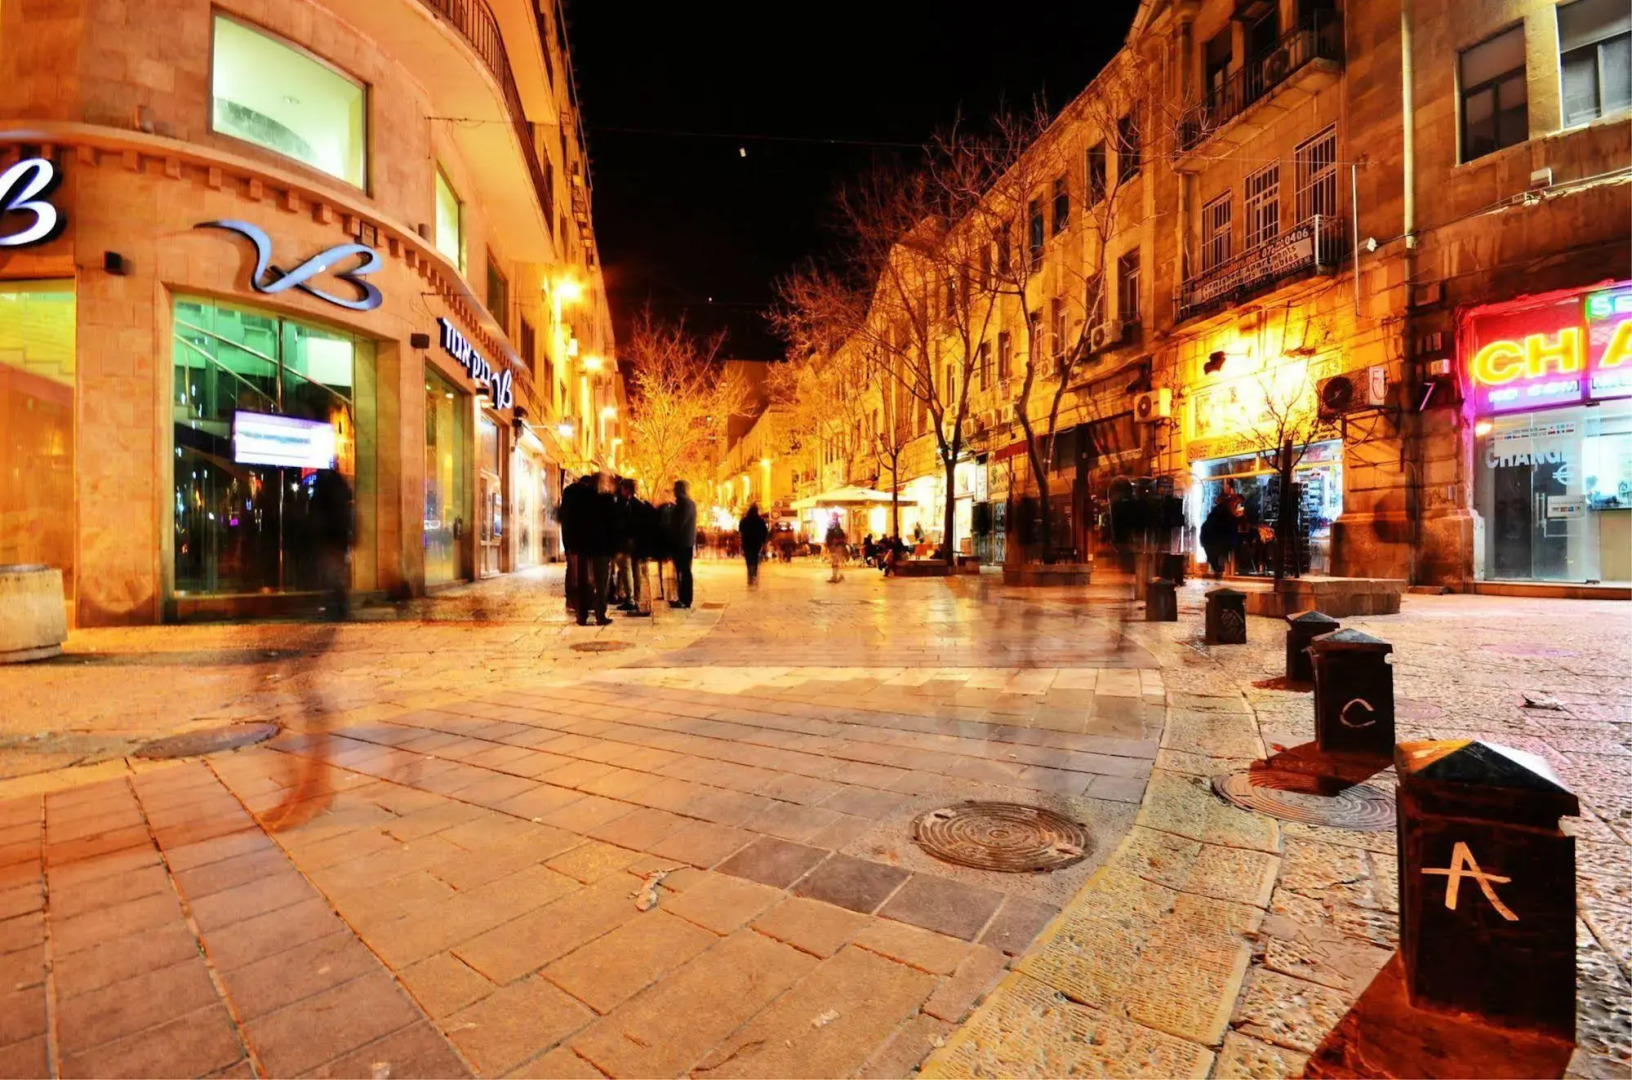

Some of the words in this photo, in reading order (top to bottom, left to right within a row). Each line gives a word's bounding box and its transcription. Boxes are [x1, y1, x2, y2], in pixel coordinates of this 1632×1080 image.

[1245, 245, 1297, 273] Apartments
[1419, 382, 1436, 412] 7
[1340, 698, 1376, 728] C
[1421, 841, 1519, 922] A
